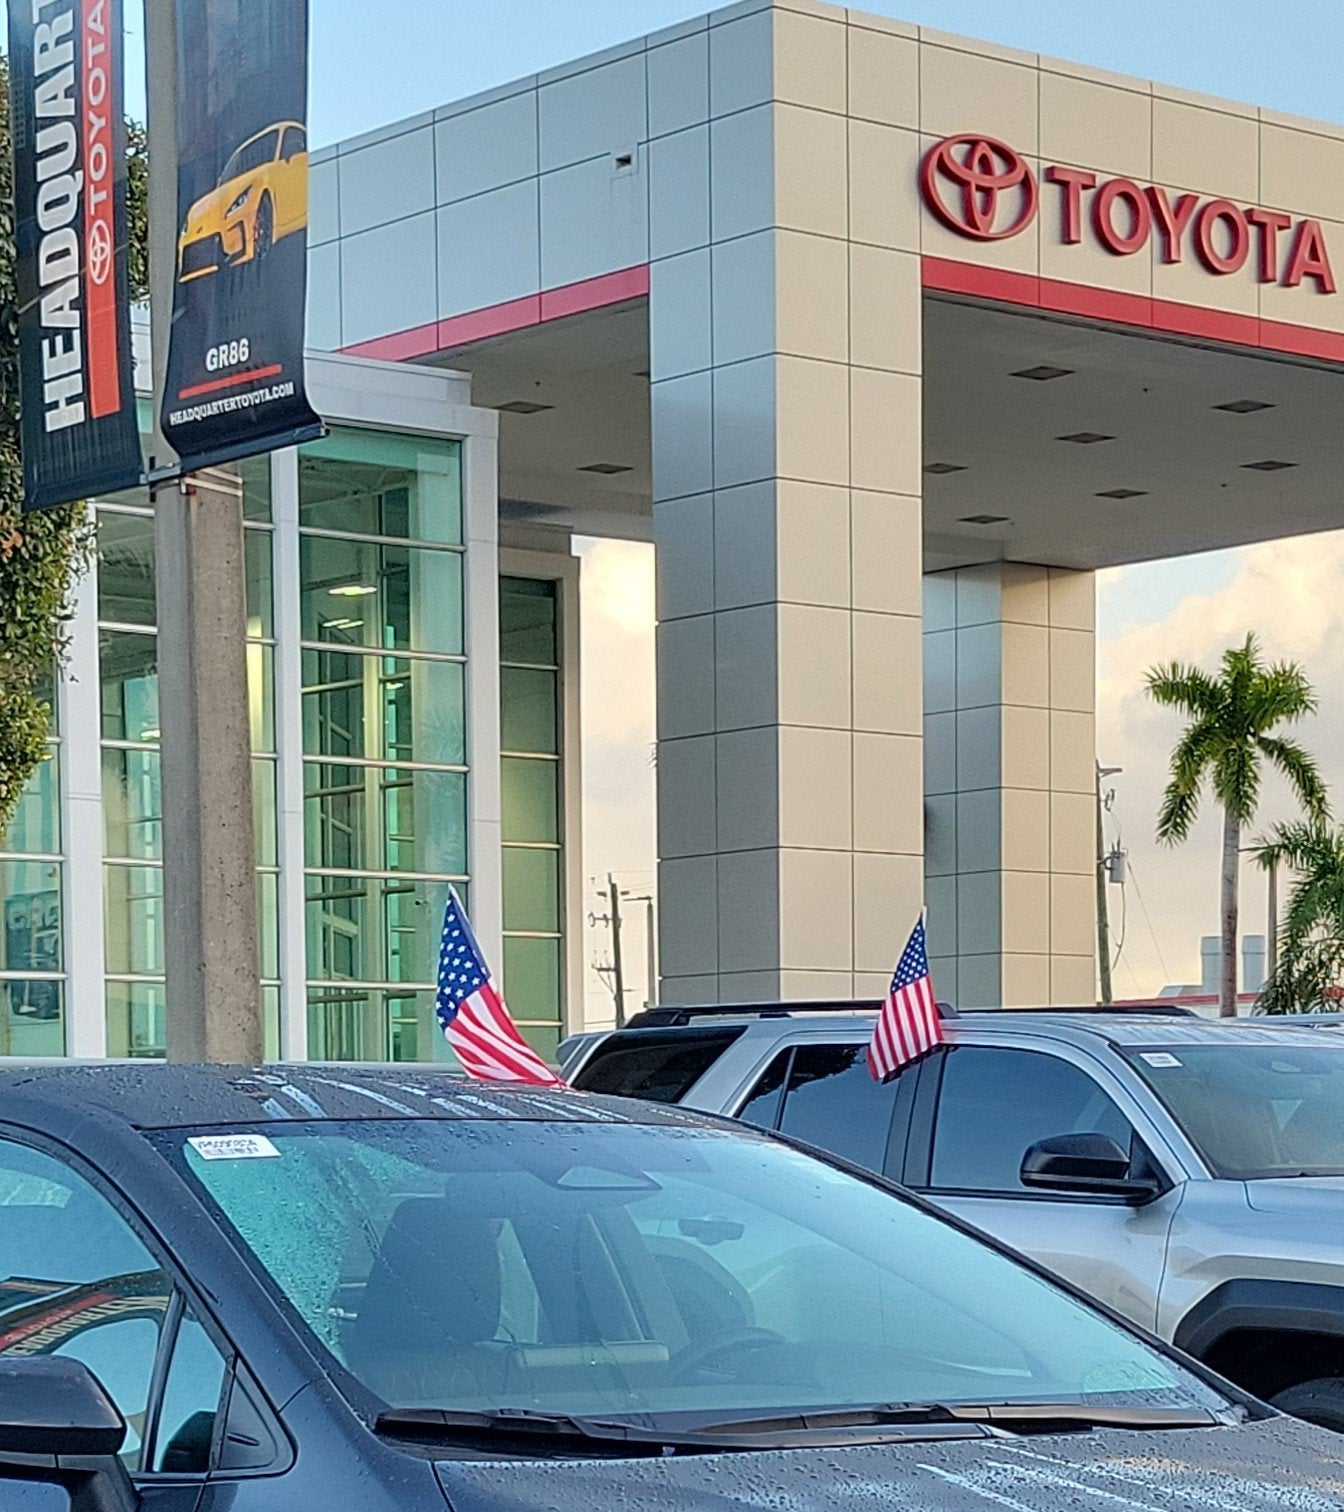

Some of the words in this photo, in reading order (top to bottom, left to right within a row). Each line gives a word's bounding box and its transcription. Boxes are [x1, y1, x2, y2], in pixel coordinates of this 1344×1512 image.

[86, 0, 107, 217] TOYOTA
[1046, 164, 1336, 294] TOYOTA
[205, 338, 250, 372] GR86
[168, 380, 295, 427] HEADQUARTERTOYOTA.COM
